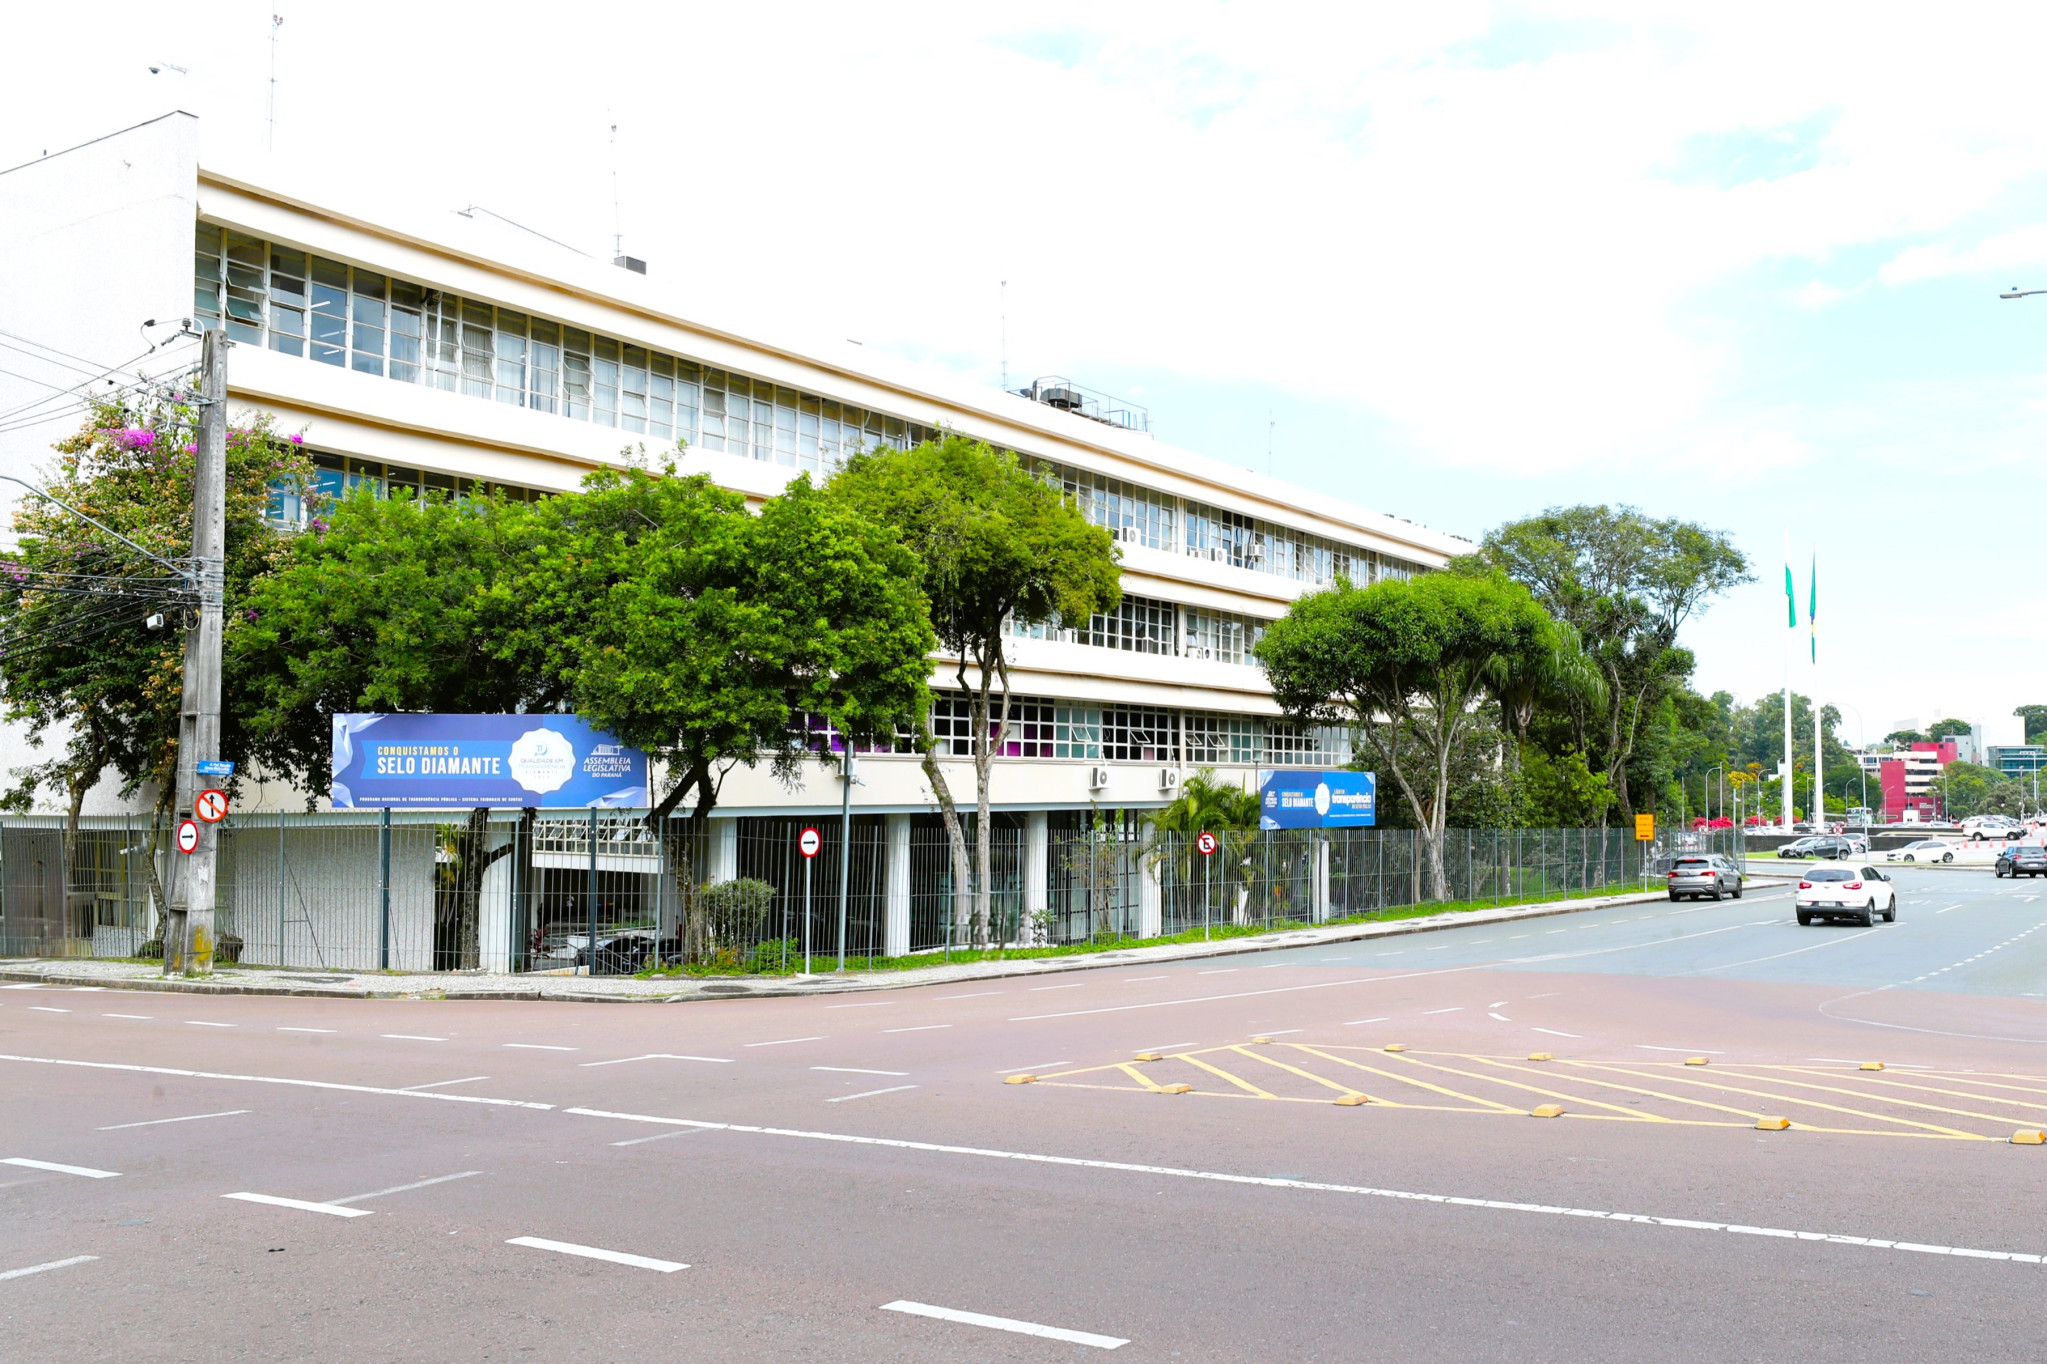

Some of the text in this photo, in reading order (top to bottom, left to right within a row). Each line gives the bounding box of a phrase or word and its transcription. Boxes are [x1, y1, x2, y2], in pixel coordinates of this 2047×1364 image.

[377, 746, 459, 756] CONQUISTAMOS O
[377, 757, 501, 774] SELO DIAMANTE
[583, 764, 631, 772] LEGISLATIVA
